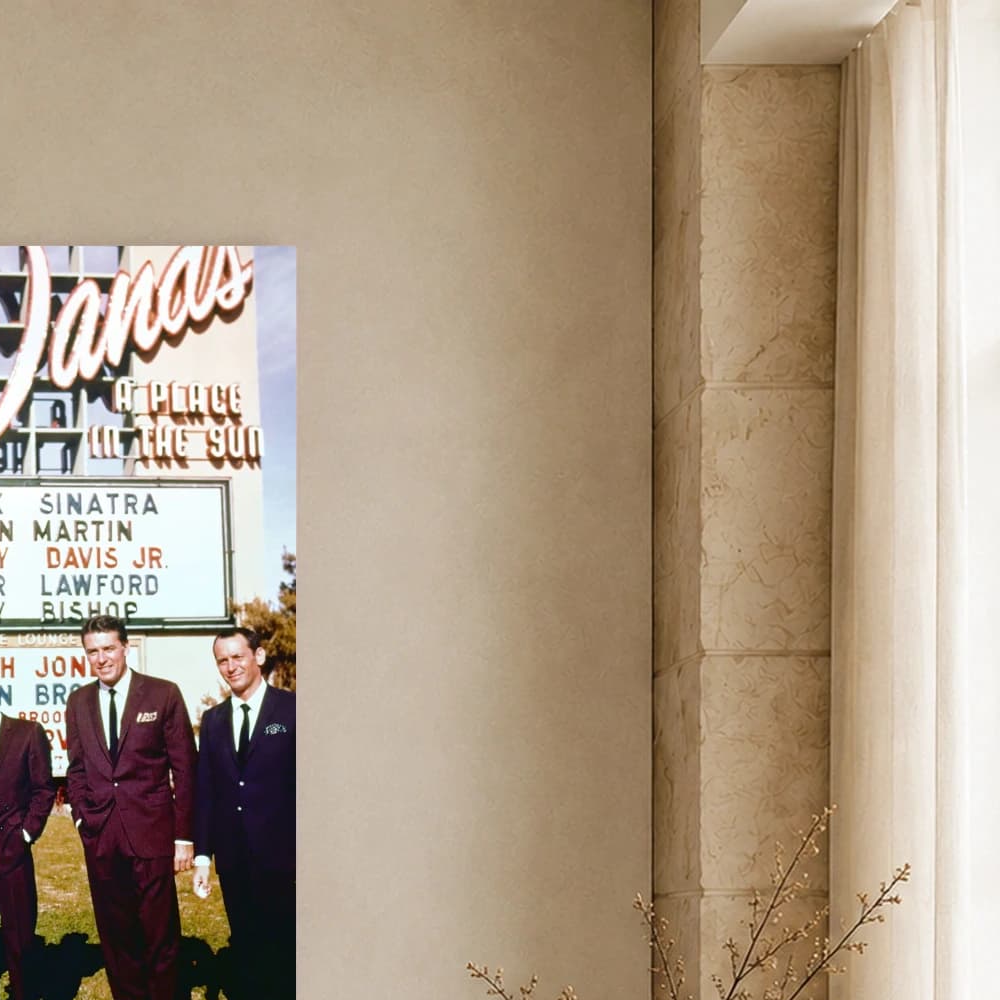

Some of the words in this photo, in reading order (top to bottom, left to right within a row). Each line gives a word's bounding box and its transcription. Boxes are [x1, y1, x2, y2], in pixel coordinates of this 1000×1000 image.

[147, 380, 242, 415] PLACE
[89, 425, 122, 458] IN
[138, 425, 188, 459] THE
[205, 426, 265, 460] SUN
[40, 492, 158, 515] SINATRA
[33, 520, 132, 542] MARTIN
[46, 547, 118, 569] DAVIS
[132, 547, 168, 569] JR.
[41, 574, 158, 596] LAWFORD
[42, 602, 137, 624] BISHOP
[18, 633, 77, 645] LOUNGE
